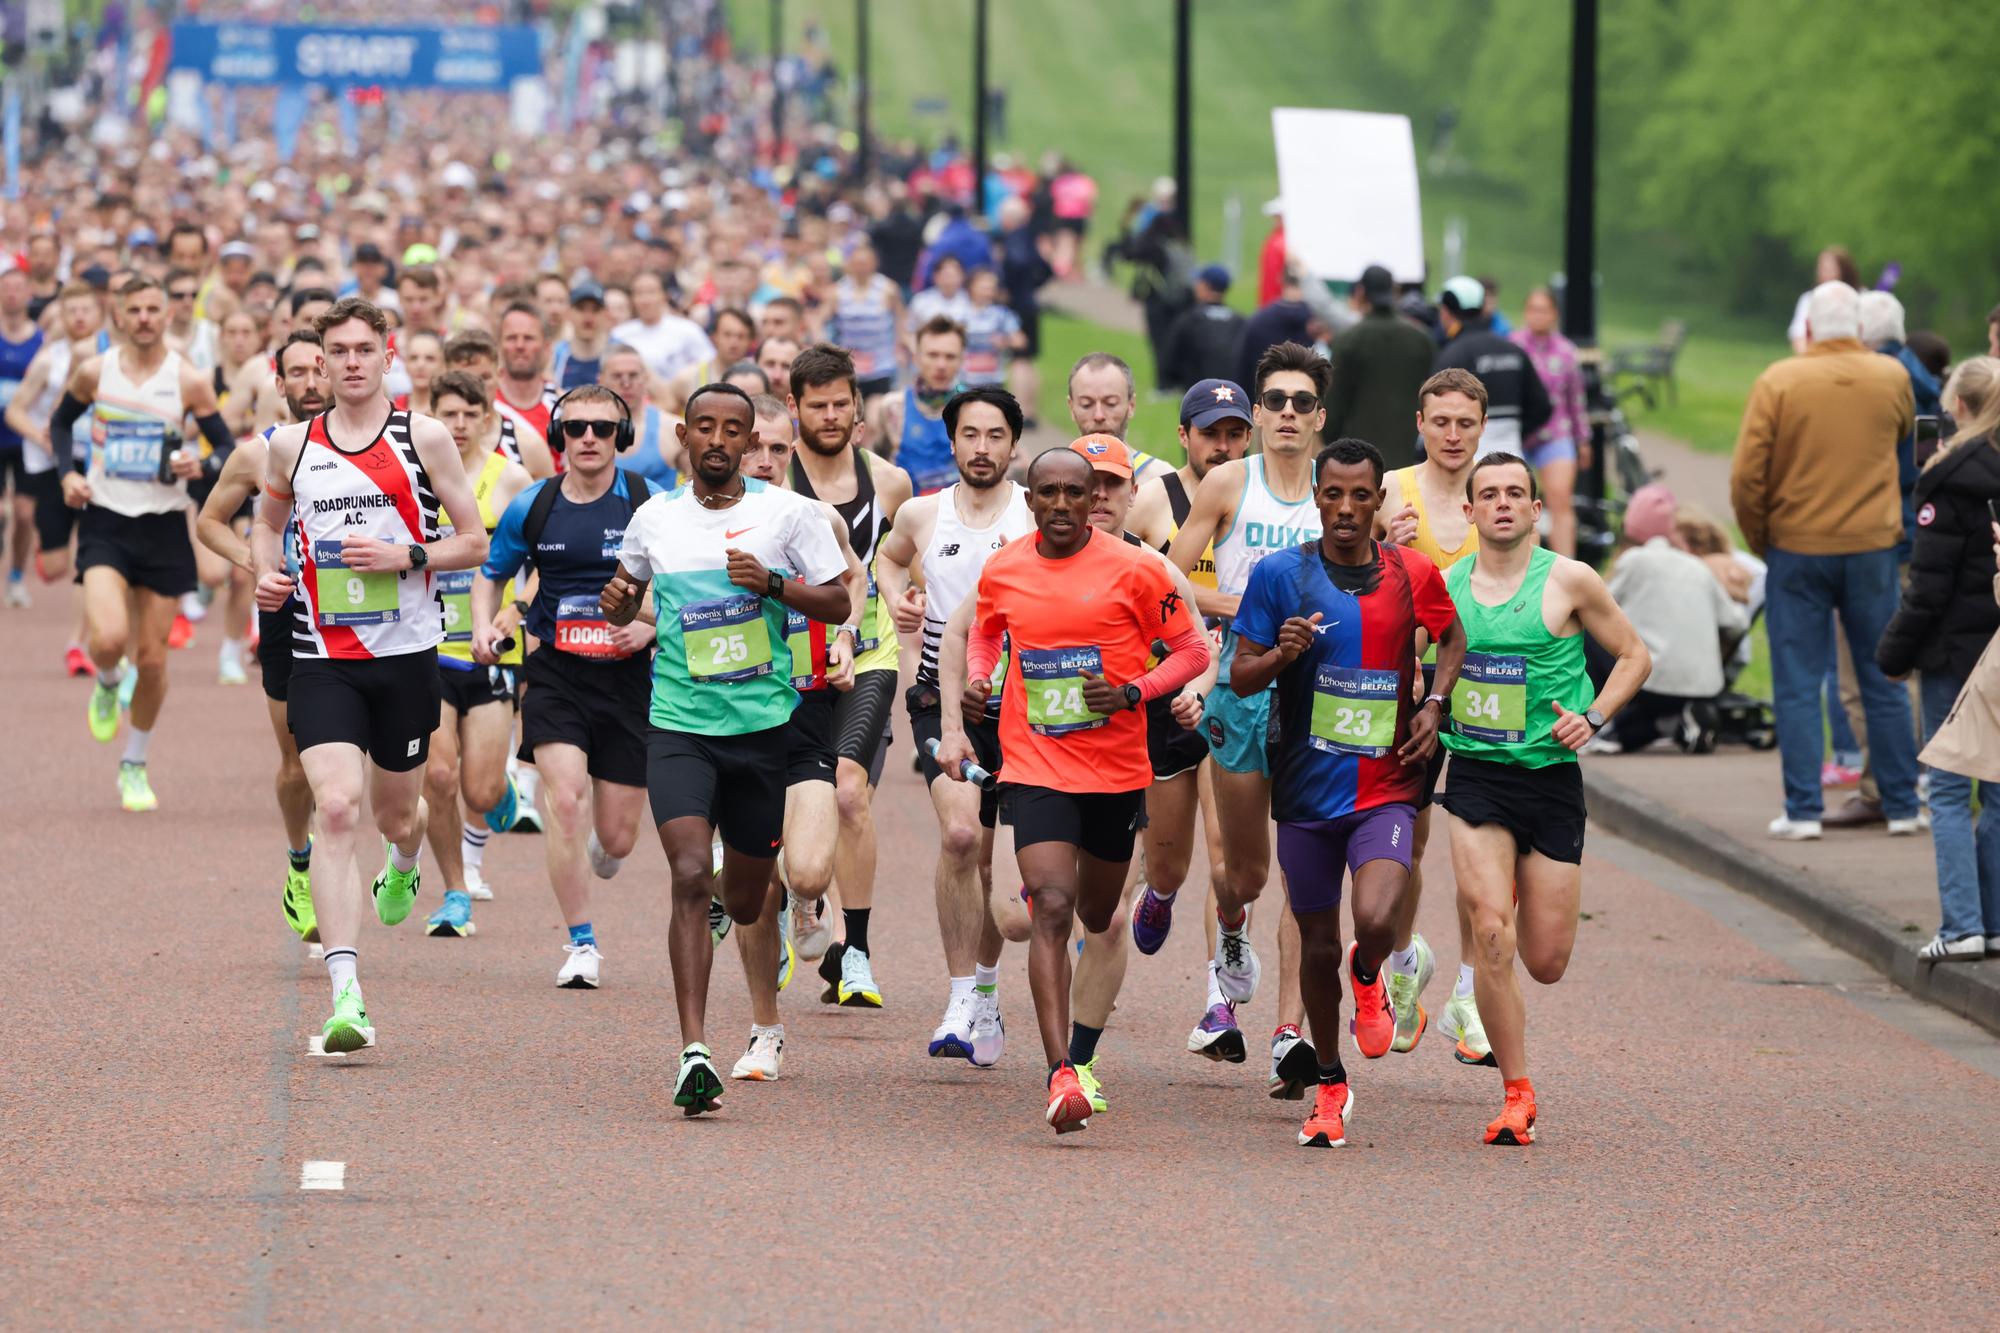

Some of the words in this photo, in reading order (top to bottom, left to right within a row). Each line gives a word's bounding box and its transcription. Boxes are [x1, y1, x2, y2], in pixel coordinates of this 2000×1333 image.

[296, 34, 418, 77] START
[310, 461, 338, 472] oneills
[313, 494, 398, 514] ROADRUNNERS
[344, 512, 367, 525] A.C.
[322, 550, 343, 560] Phoe
[537, 543, 565, 551] KUKRI
[346, 577, 366, 605] 9
[689, 609, 722, 622] Phoenix
[725, 603, 759, 617] BELFAST
[787, 616, 806, 625] FAST
[709, 633, 748, 665] 25
[1027, 660, 1057, 670] Phoenix
[1061, 658, 1098, 669] BELFAST
[1461, 663, 1482, 673] oenix
[1486, 667, 1523, 676] BELFAST
[1324, 676, 1357, 689] Phoenix
[1361, 683, 1397, 691] BELFAST
[1043, 687, 1083, 717] 24
[1466, 690, 1501, 720] 34
[1333, 707, 1372, 737] 23
